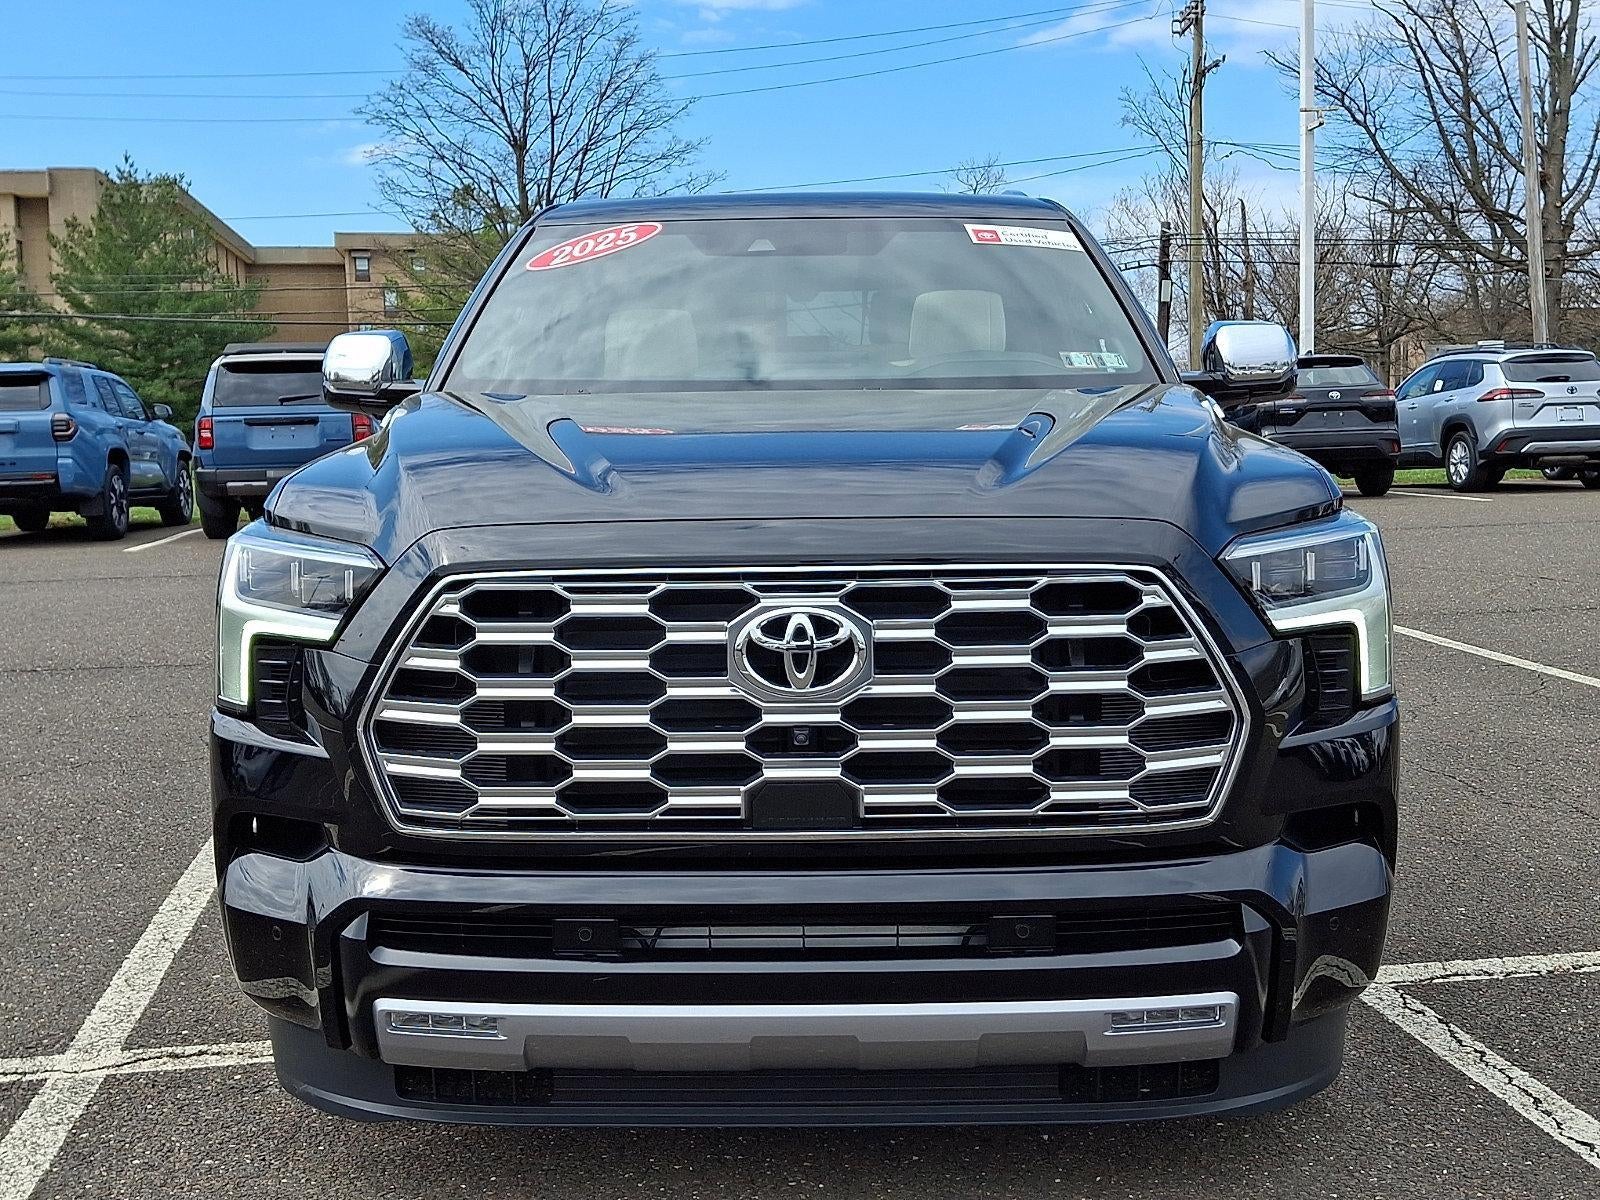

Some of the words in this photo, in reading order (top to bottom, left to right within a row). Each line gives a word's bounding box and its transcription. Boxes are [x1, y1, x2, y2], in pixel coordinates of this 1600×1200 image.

[1001, 229, 1048, 239] Certified
[549, 225, 639, 266] 2025
[1004, 236, 1032, 244] Used
[1036, 238, 1078, 249] Vehicles
